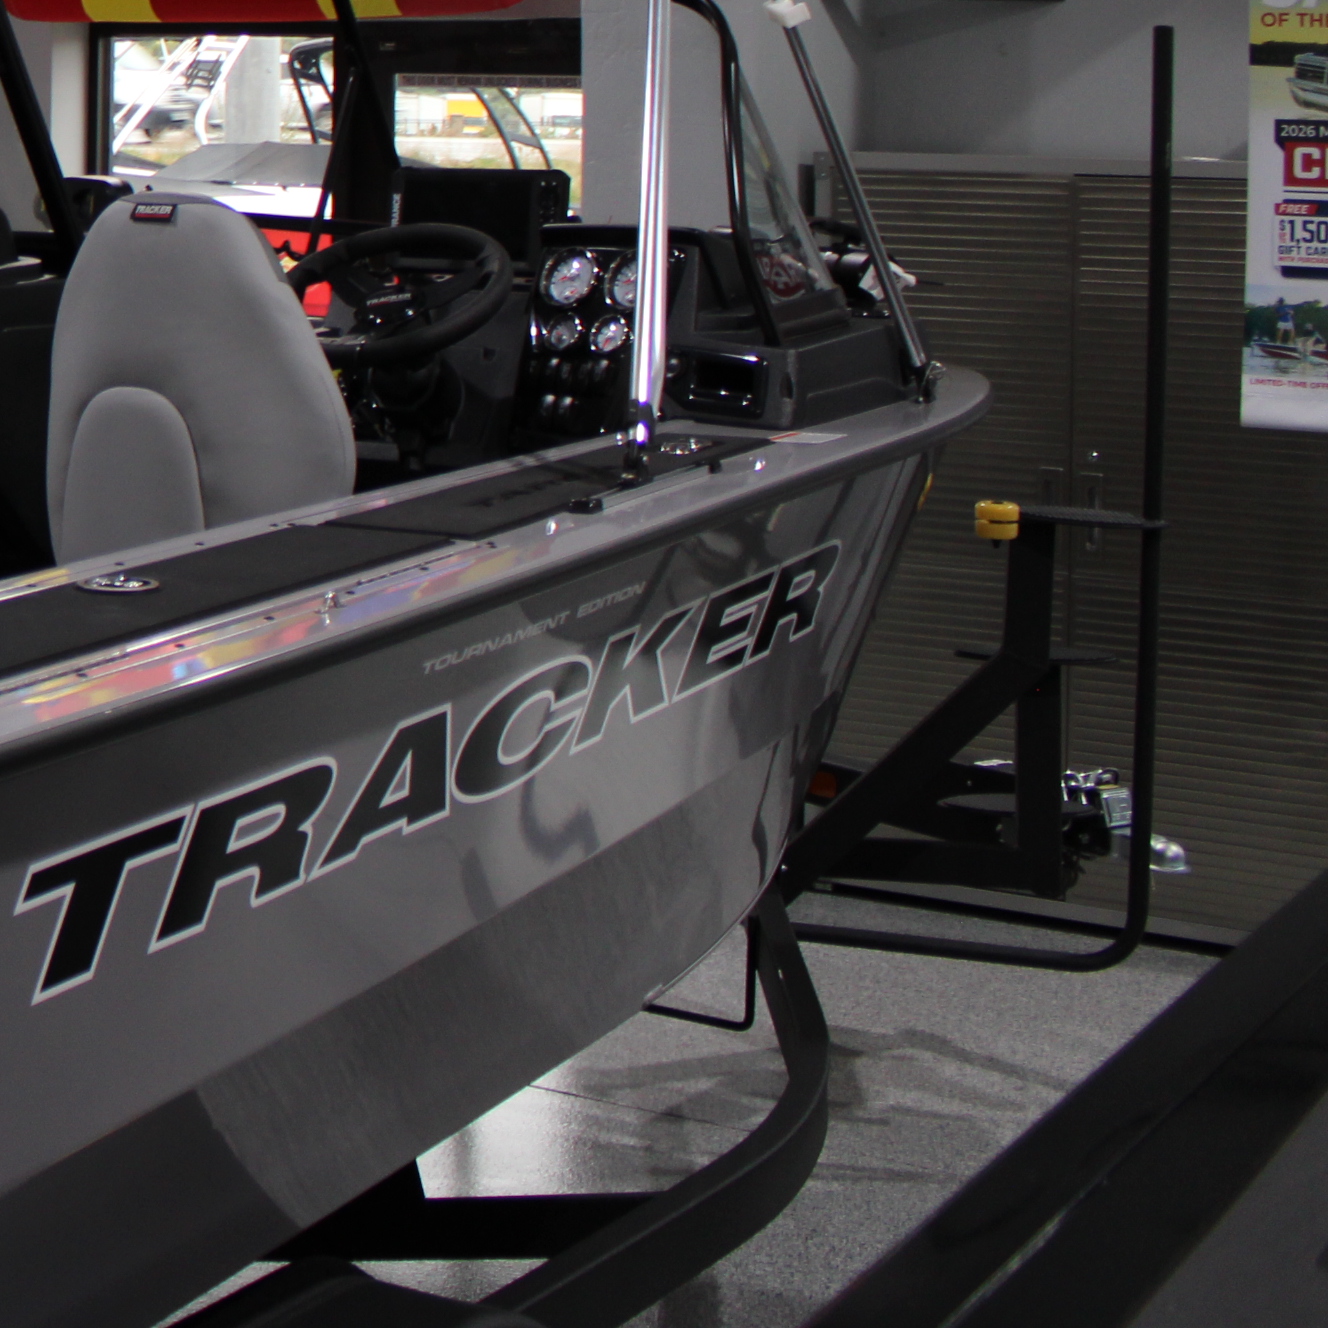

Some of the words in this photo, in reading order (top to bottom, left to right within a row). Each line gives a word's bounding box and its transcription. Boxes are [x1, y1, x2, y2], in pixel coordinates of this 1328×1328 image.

[1260, 13, 1290, 27] OF
[1280, 125, 1316, 137] 2026
[133, 203, 174, 219] TRACKER
[1278, 204, 1309, 214] FREE
[1278, 245, 1302, 255] GIFT
[423, 608, 570, 675] TOURNAMENT
[576, 580, 646, 618] EDITION
[14, 539, 842, 1006] TRACKER
